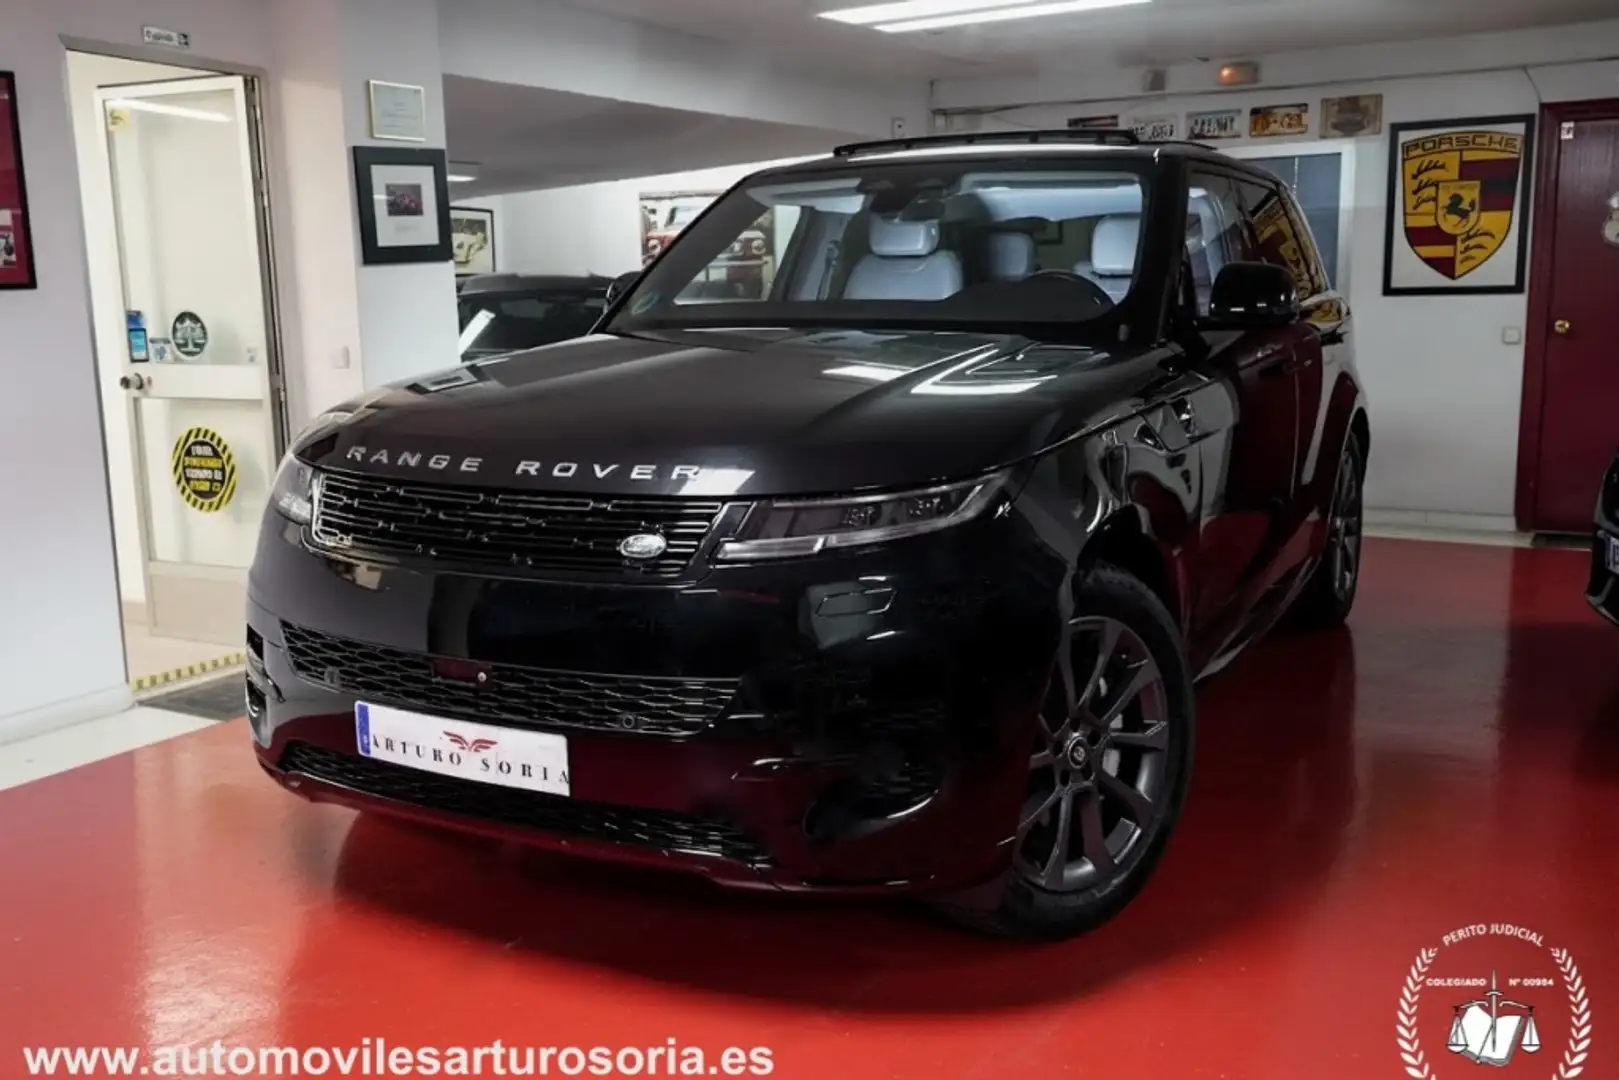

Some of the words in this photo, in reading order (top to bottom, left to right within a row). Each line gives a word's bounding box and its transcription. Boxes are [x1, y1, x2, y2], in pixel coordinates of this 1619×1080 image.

[1405, 134, 1519, 157] PORSCHE
[346, 446, 483, 473] RANGE
[515, 460, 701, 481] ROVER
[372, 735, 463, 766] ARTURO
[480, 757, 569, 784] SORIA
